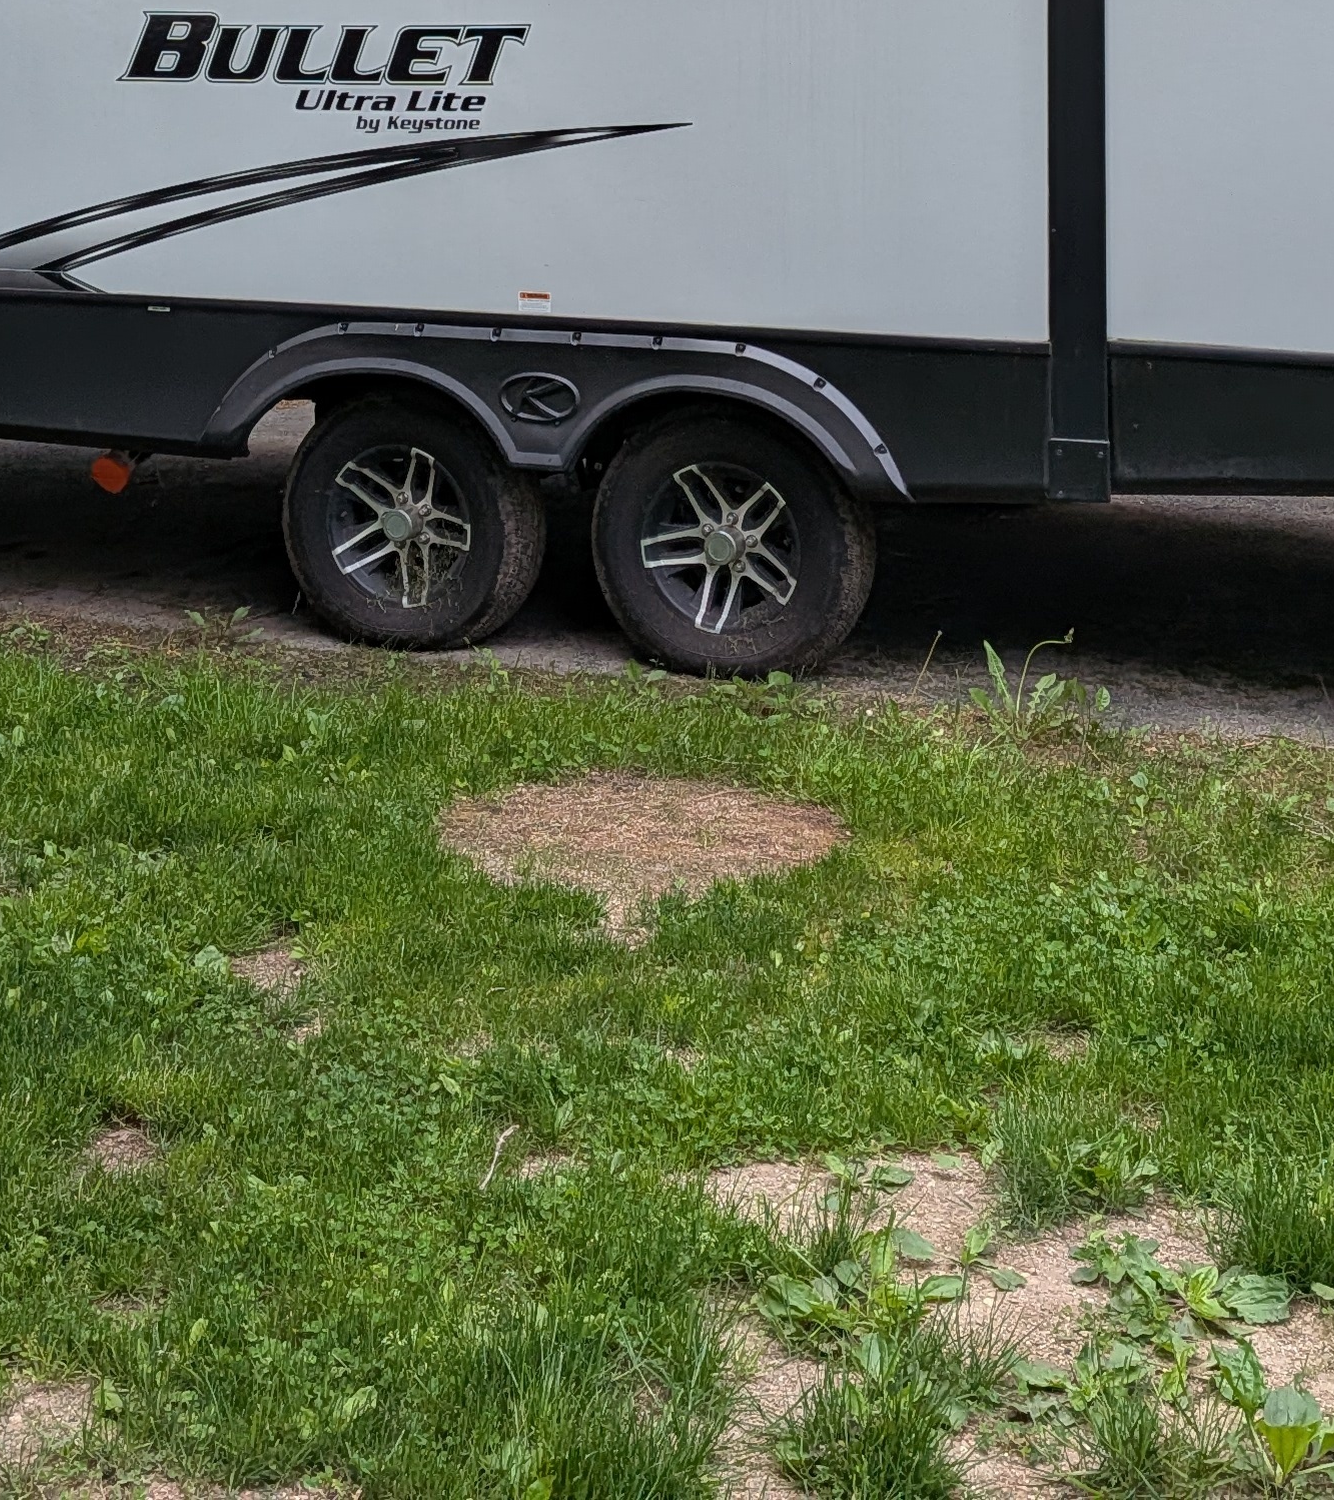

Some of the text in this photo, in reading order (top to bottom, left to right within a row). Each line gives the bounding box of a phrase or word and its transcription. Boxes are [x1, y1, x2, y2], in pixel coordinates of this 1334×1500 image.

[116, 11, 532, 85] BULLET
[295, 89, 487, 112] Ultra Lite
[355, 116, 481, 134] by Keystone
